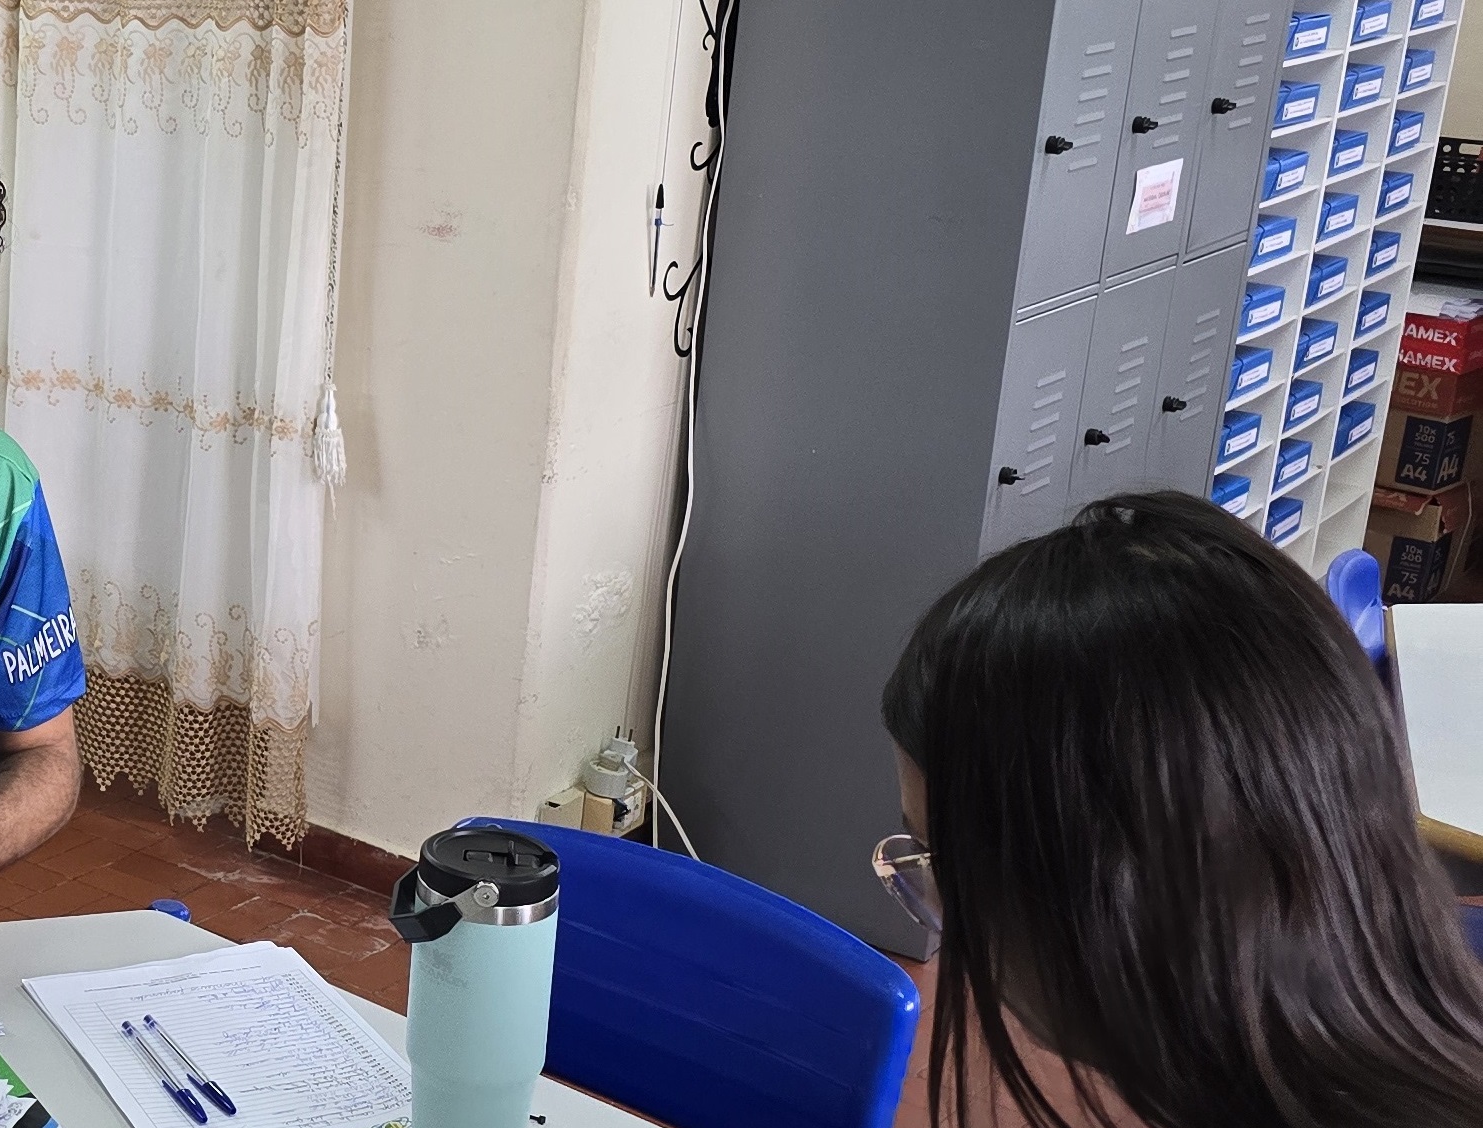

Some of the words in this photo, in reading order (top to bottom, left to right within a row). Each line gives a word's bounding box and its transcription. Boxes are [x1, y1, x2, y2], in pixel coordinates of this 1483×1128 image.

[1405, 324, 1457, 346] AMEX
[1414, 432, 1435, 444] 500
[1414, 452, 1431, 465] 75
[1400, 463, 1427, 482] A4
[1437, 454, 1459, 484] A4
[1401, 571, 1418, 584] 75
[1387, 583, 1415, 601] A4
